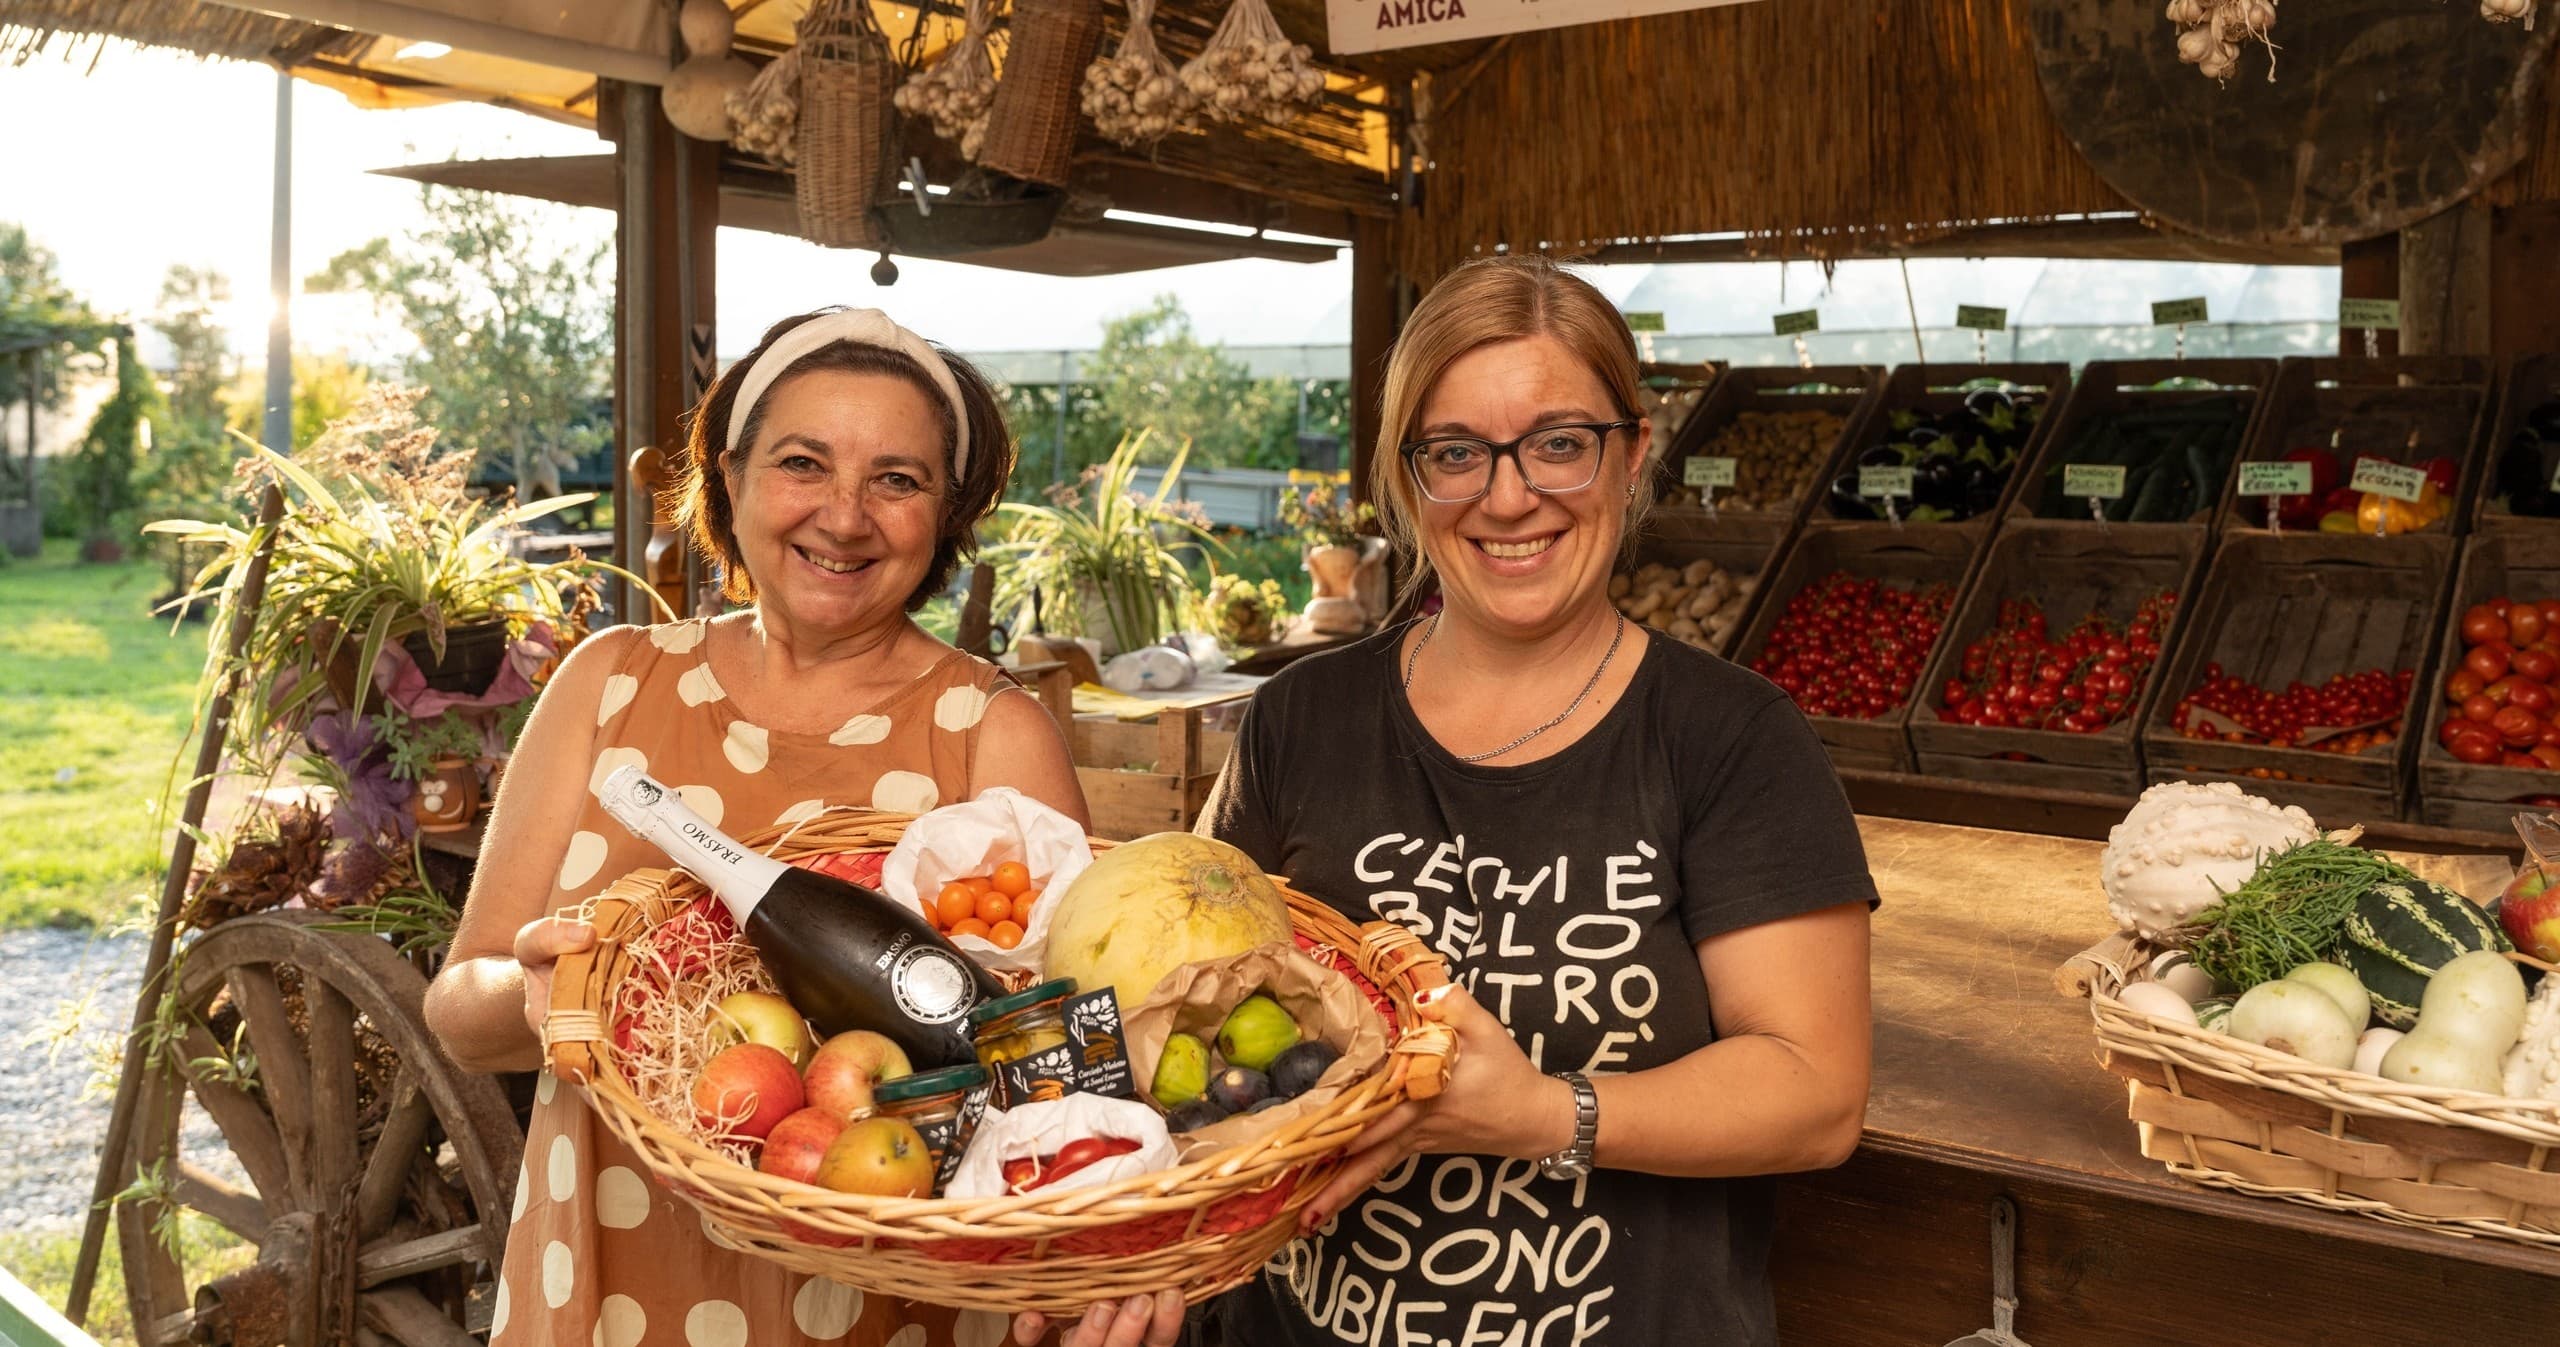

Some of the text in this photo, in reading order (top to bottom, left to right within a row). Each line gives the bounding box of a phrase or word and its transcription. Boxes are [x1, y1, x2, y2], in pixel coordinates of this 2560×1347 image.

[1376, 0, 1466, 30] AMICA
[682, 822, 744, 865] ERASMO
[1606, 839, 1662, 911] È
[875, 931, 913, 972] ERASMO
[1351, 1198, 1611, 1294] SONO
